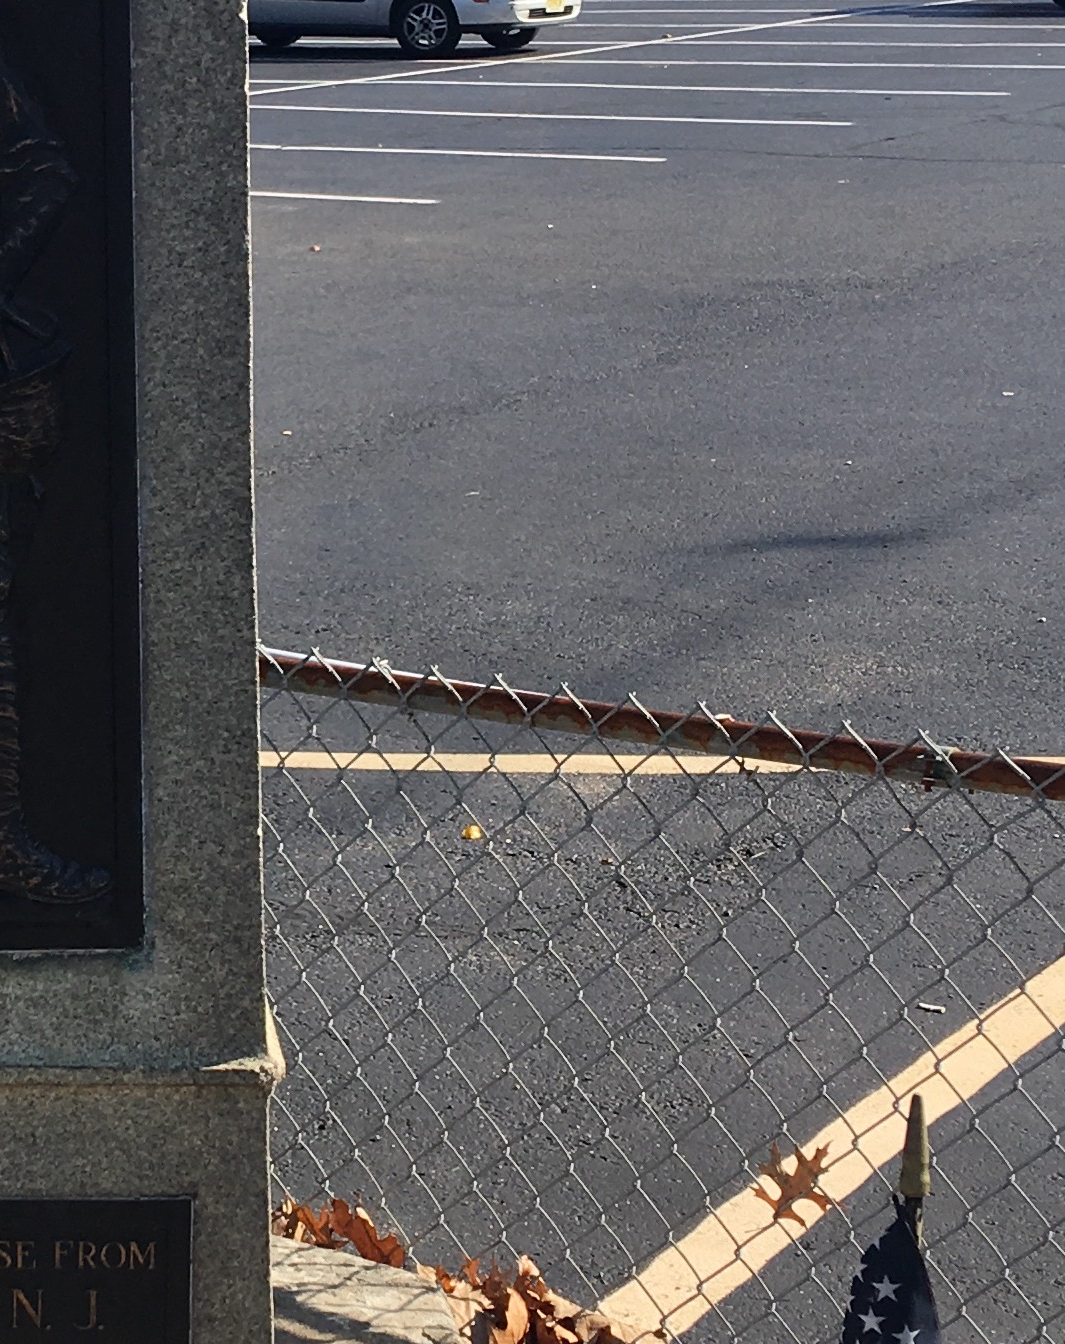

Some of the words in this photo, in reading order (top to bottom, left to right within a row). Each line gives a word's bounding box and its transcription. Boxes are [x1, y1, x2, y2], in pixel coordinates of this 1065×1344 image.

[54, 1241, 157, 1271] FROM
[12, 1289, 52, 1330] N.
[73, 1289, 105, 1331] J.
